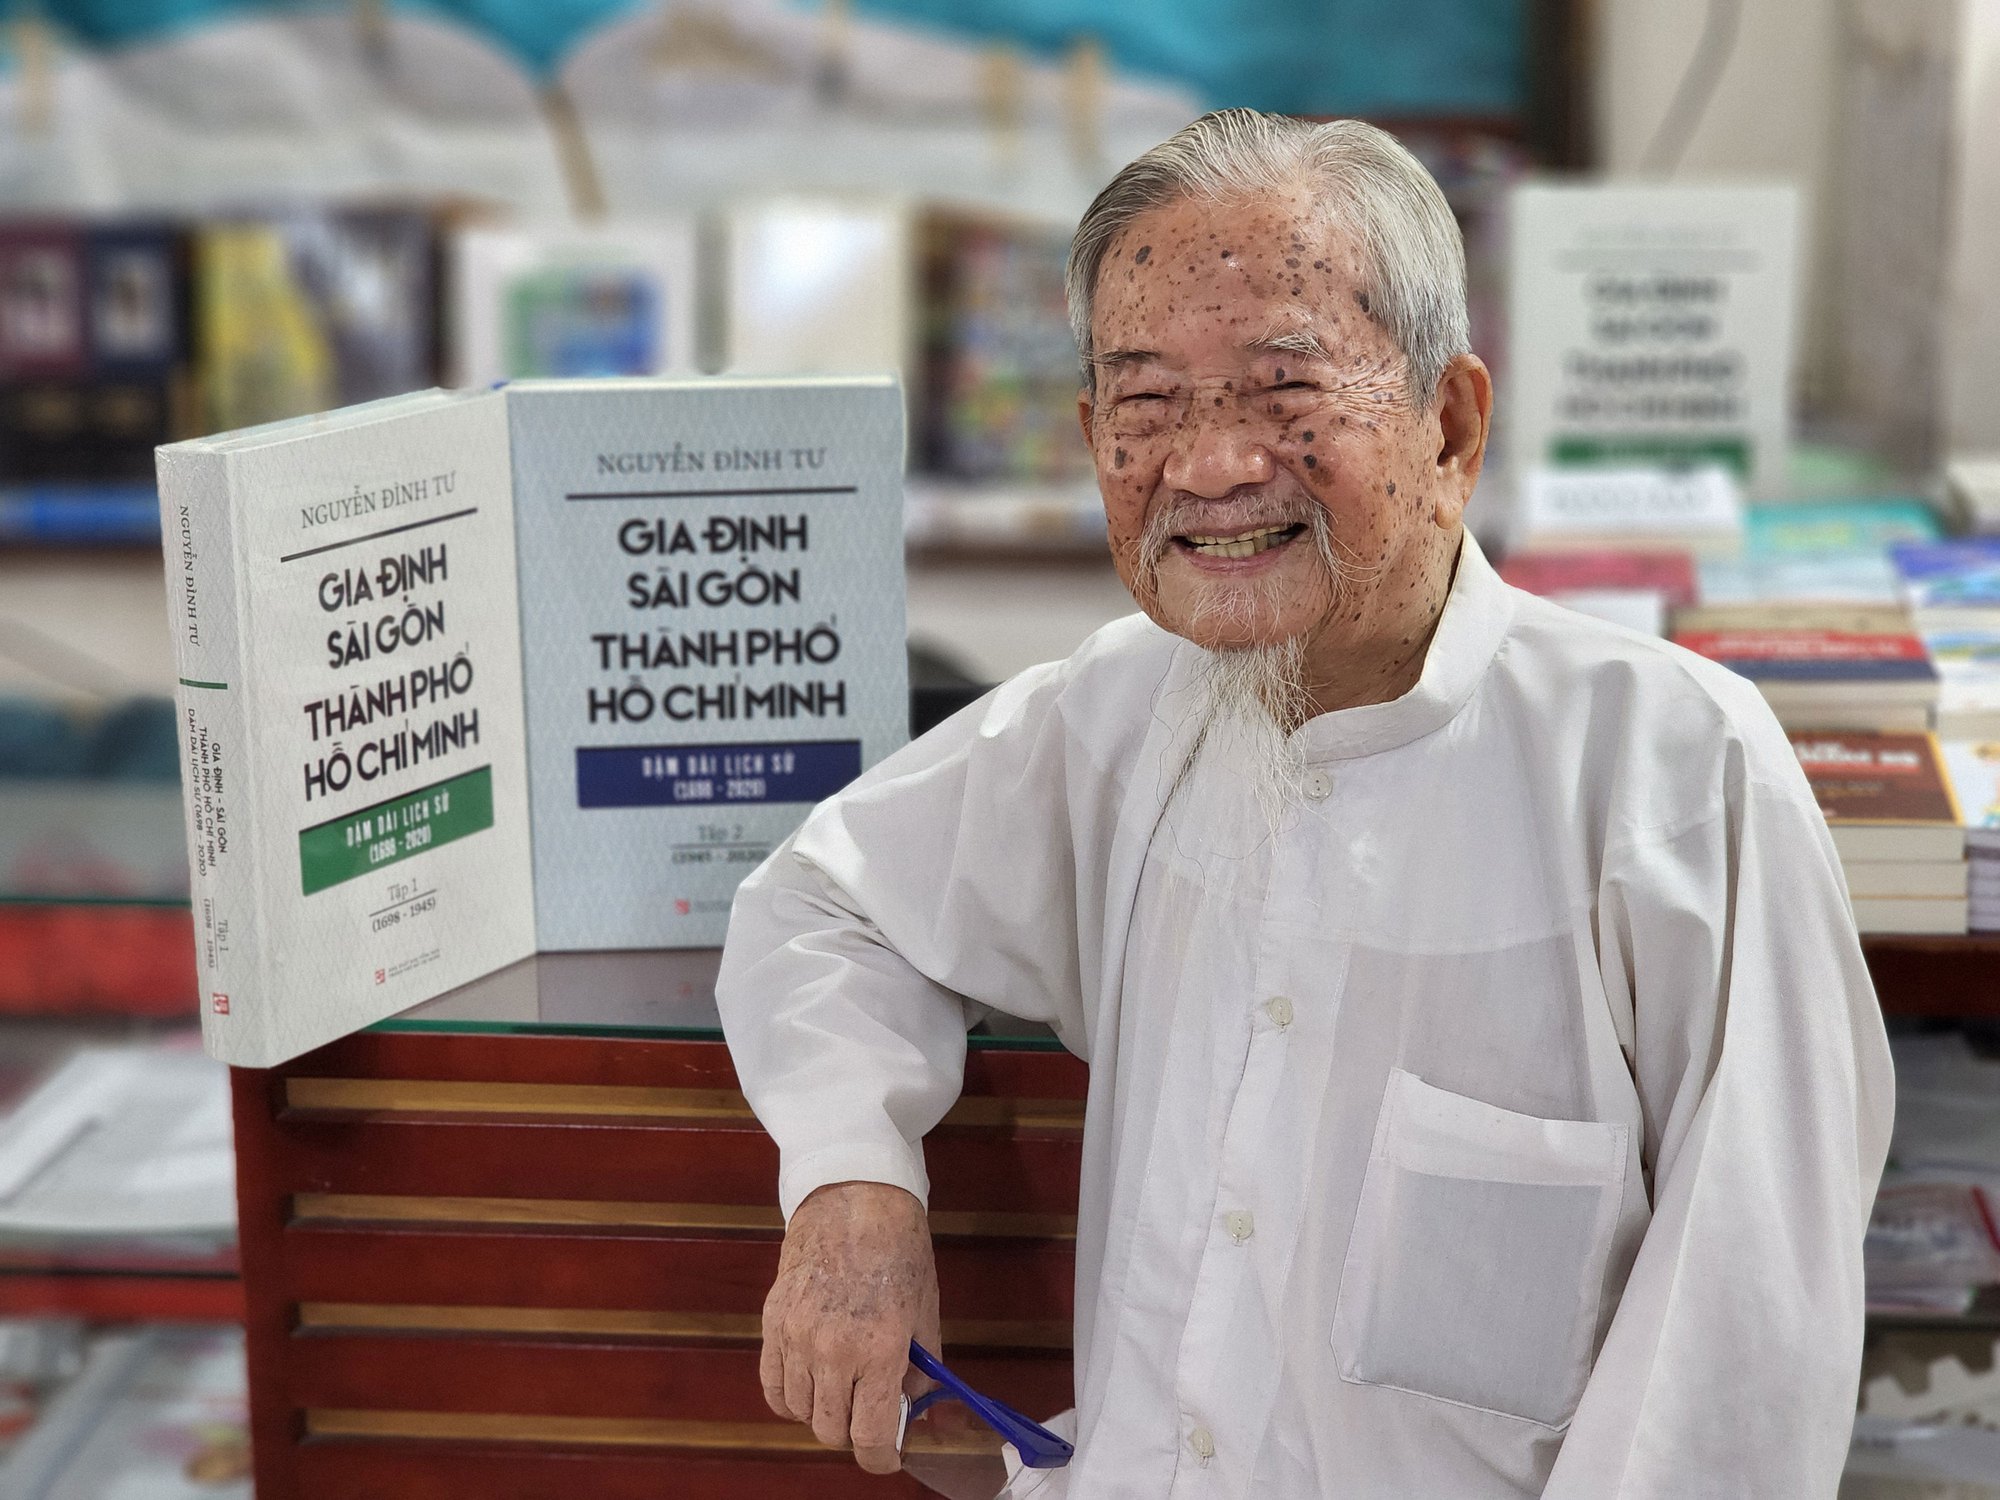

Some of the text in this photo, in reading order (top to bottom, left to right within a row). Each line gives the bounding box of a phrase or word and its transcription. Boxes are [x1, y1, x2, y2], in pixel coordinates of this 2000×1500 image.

[597, 442, 827, 474] NGUYỄN ĐÌNH TƯ
[301, 470, 457, 529] NGUYỄN ĐÌNH TƯ
[618, 514, 807, 563] GIA ĐỊNH
[180, 505, 201, 646] NGUYỄN ĐÌNH TƯ
[318, 543, 447, 612] GIA ĐỊNH
[628, 566, 689, 610] SÀI
[327, 600, 445, 669] SÀI GÒN
[591, 613, 841, 670] THÀNH PHỐ
[304, 641, 473, 741] THÀNH PHỐ
[588, 672, 847, 724] HỒ CHÍ MINH
[199, 727, 210, 764] THÀNH
[211, 743, 221, 762] GIA
[304, 708, 479, 802] HỒ CHÍ MINH
[191, 758, 200, 783] LỊCH
[211, 766, 224, 794] ĐỊNH
[194, 804, 203, 831] (1698
[204, 796, 215, 813] HỒ
[216, 807, 226, 823] SÀI
[402, 800, 429, 827] LỊCH
[434, 789, 450, 815] SỬ
[205, 817, 216, 838] CHÍ
[405, 824, 431, 850] 2020)
[198, 844, 207, 876] 2020)
[207, 841, 216, 867] MINH
[412, 878, 418, 892] 1
[372, 911, 400, 933] (1698
[410, 896, 436, 917] 1945)
